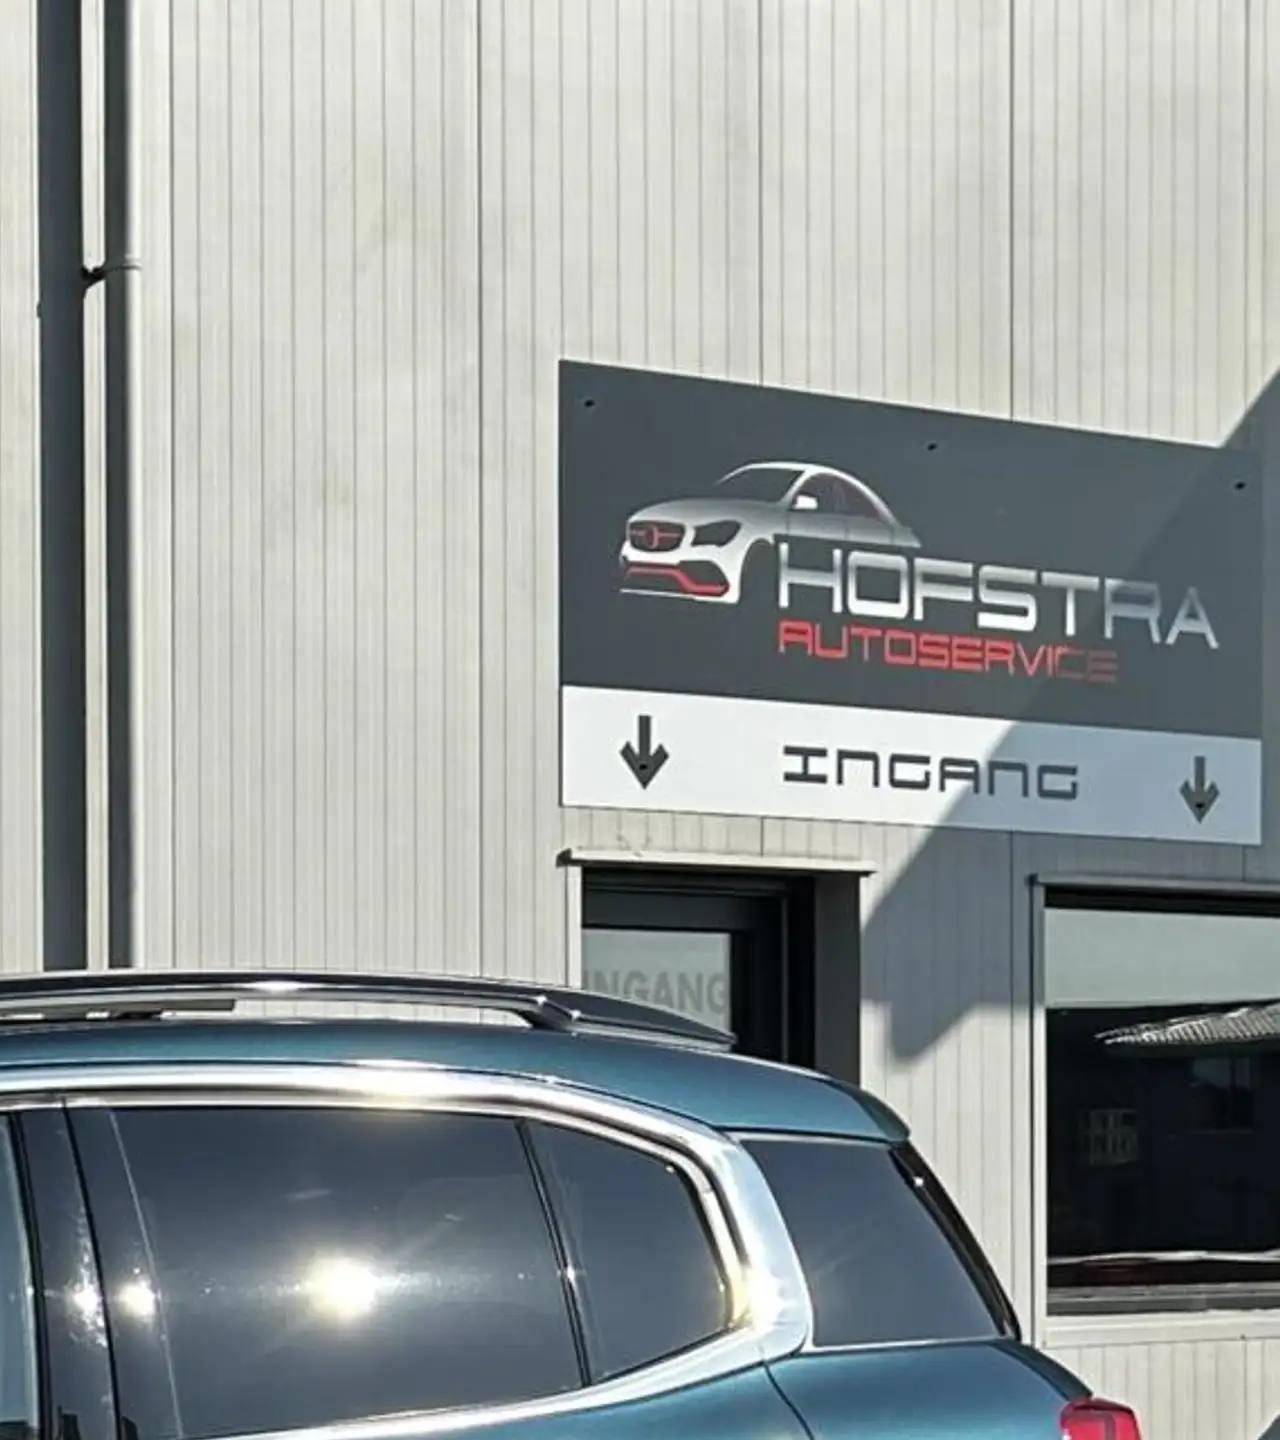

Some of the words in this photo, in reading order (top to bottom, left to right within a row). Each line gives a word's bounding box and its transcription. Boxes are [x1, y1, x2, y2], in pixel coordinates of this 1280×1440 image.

[778, 542, 1220, 649] HOFSTRA
[778, 619, 1120, 683] AUTOSERVICE
[782, 745, 1079, 801] INGANG
